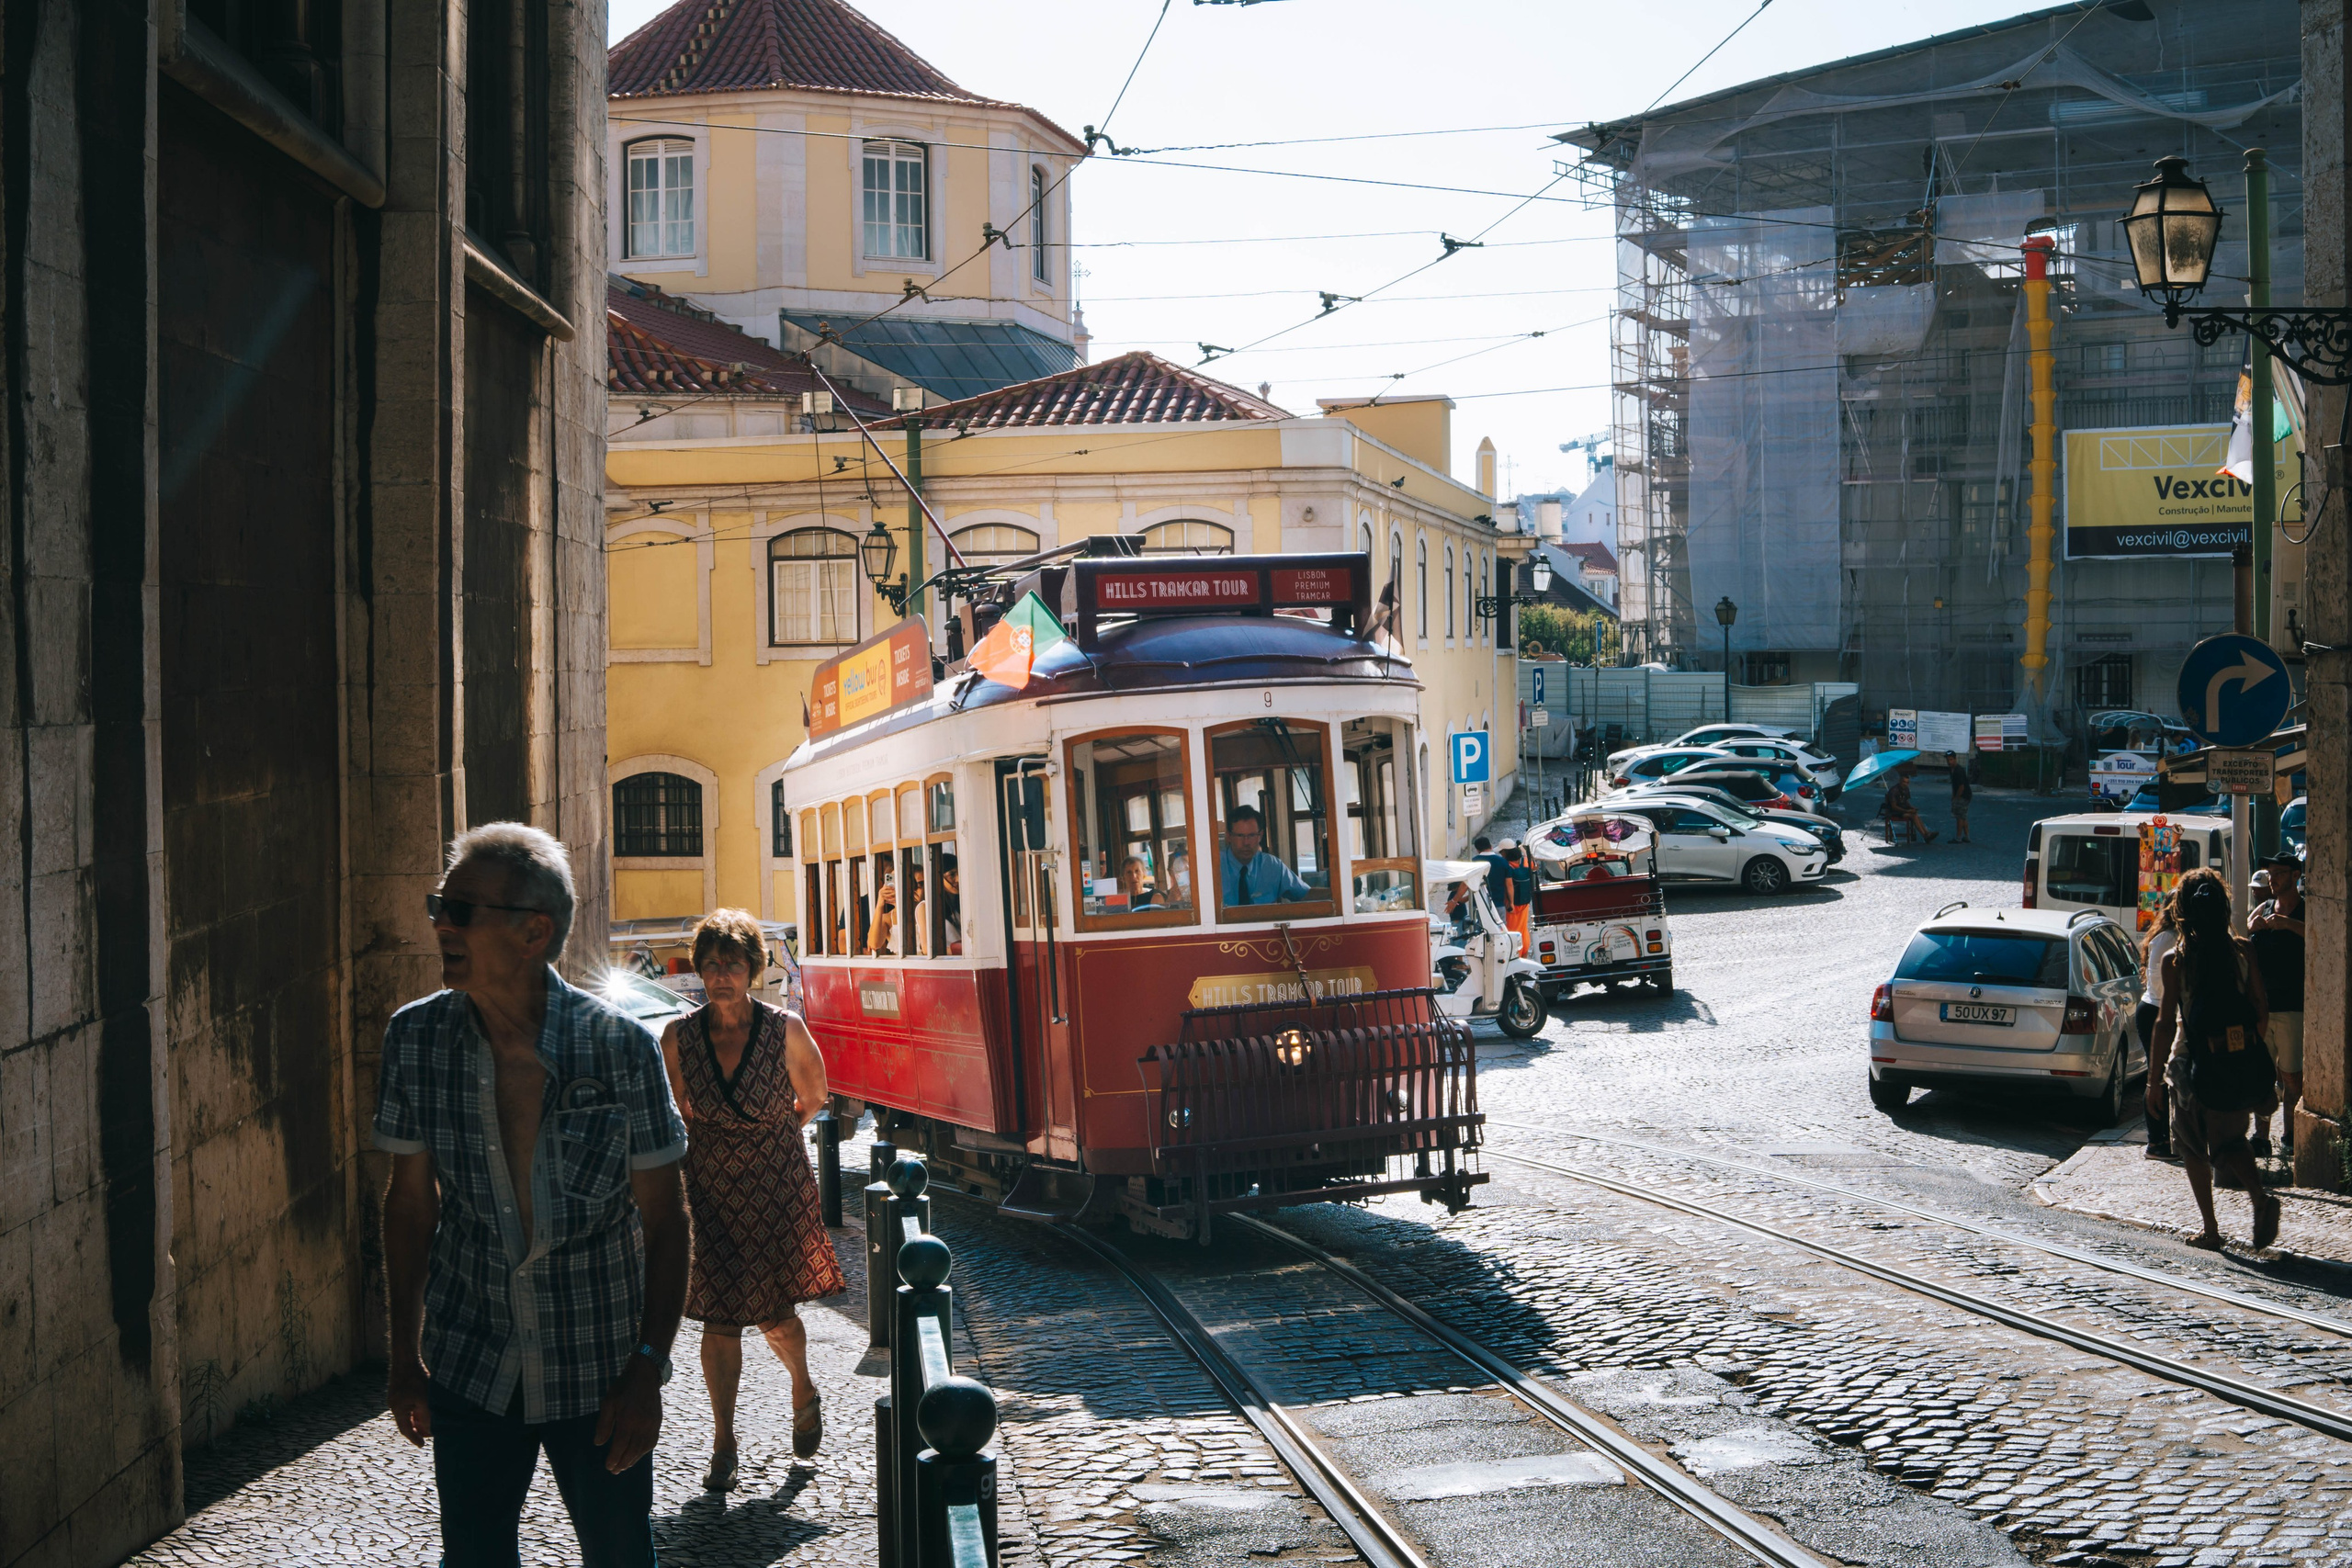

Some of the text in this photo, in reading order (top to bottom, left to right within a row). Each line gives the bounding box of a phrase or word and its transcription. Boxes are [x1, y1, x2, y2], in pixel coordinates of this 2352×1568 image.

[2154, 475, 2252, 501] Vexciv
[2159, 504, 2252, 516] Construção Manute
[2117, 528, 2252, 548] vexcivil@vexcivil.
[1297, 570, 1327, 581] LISBON
[1105, 579, 1249, 600] HILLS TRAMCAR TOUR
[1295, 581, 1330, 591] PREMIUM
[1295, 591, 1331, 601] TRAMCAR
[894, 644, 910, 665] TICKETS
[896, 668, 910, 688] INSIDE
[1535, 672, 1543, 700] P
[823, 681, 837, 698] TICKETS
[1263, 691, 1272, 708] 9
[825, 702, 836, 718] INSIDE
[1459, 737, 1482, 779] P
[2116, 759, 2136, 770] Tour
[2211, 768, 2269, 776] TRANSPORTES
[2220, 775, 2260, 784] PÚBLICOS
[1202, 985, 1252, 1007] HILLS
[1327, 976, 1363, 997] TOUR
